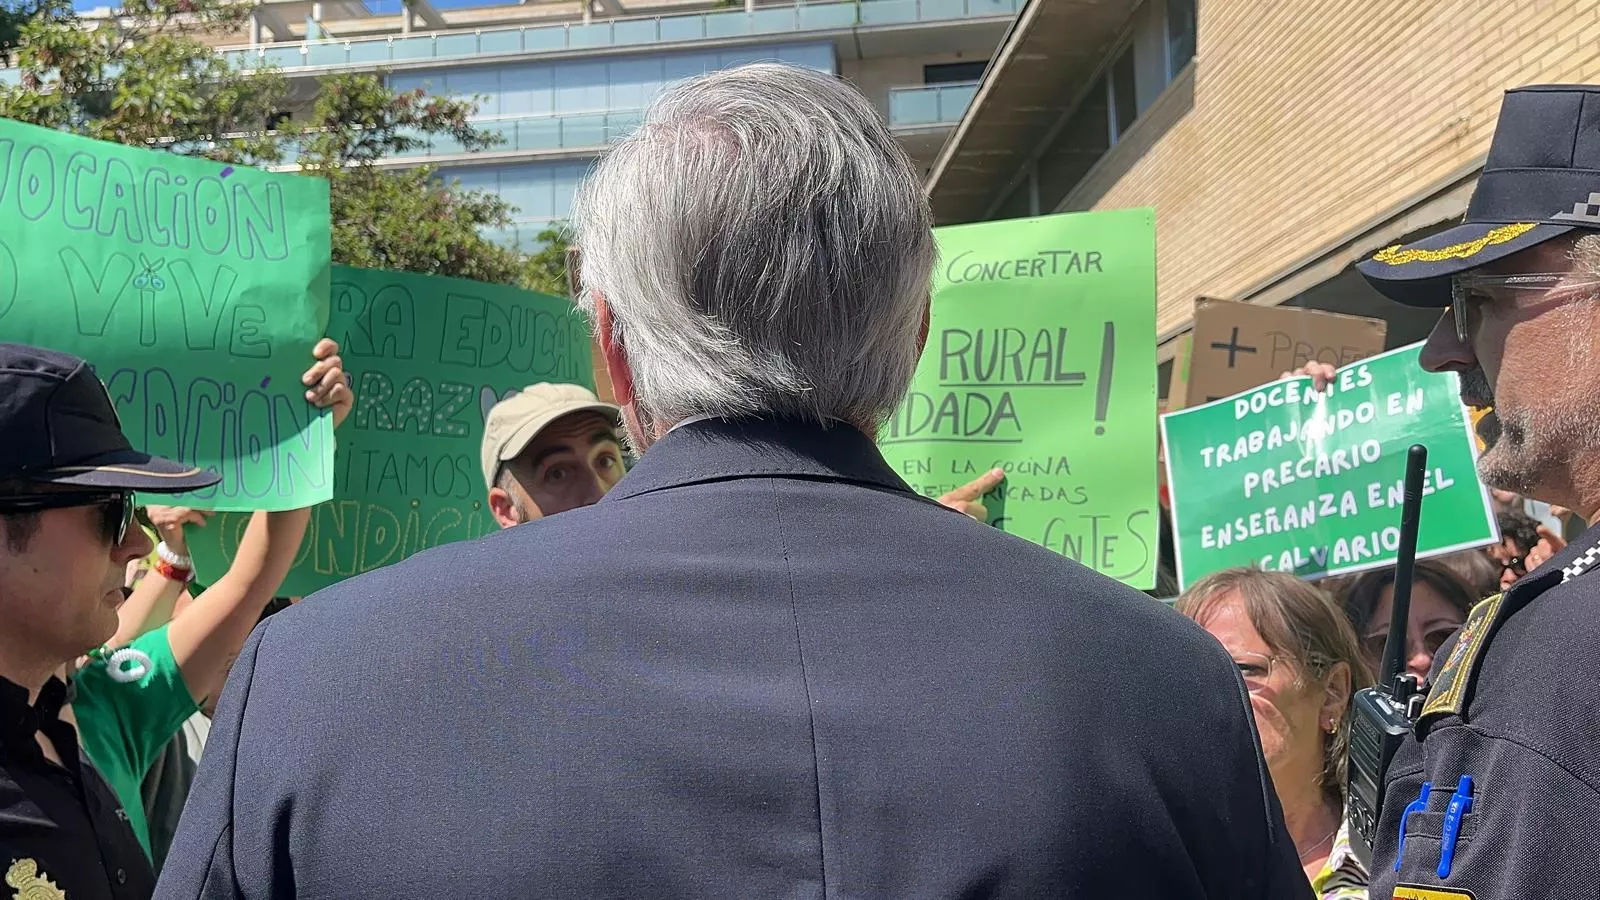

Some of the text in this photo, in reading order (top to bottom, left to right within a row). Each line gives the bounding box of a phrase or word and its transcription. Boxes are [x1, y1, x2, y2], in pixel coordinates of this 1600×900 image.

[0, 139, 289, 260] OCACiÓN
[946, 250, 1103, 284] CONCERTAR
[329, 281, 588, 380] RA EDUCAR
[939, 327, 1086, 383] RURAL
[1263, 330, 1376, 371] PROF
[1200, 388, 1424, 468] TRABAJANDO EN
[334, 442, 472, 499] iTAMOS
[903, 459, 931, 475] EN
[951, 459, 977, 475] LA
[1243, 439, 1382, 499] PRECARIO
[1201, 467, 1455, 549] ENSEÑANZA EN EL
[1043, 509, 1150, 580] ENTES
[1260, 526, 1401, 572] CALVARIO
